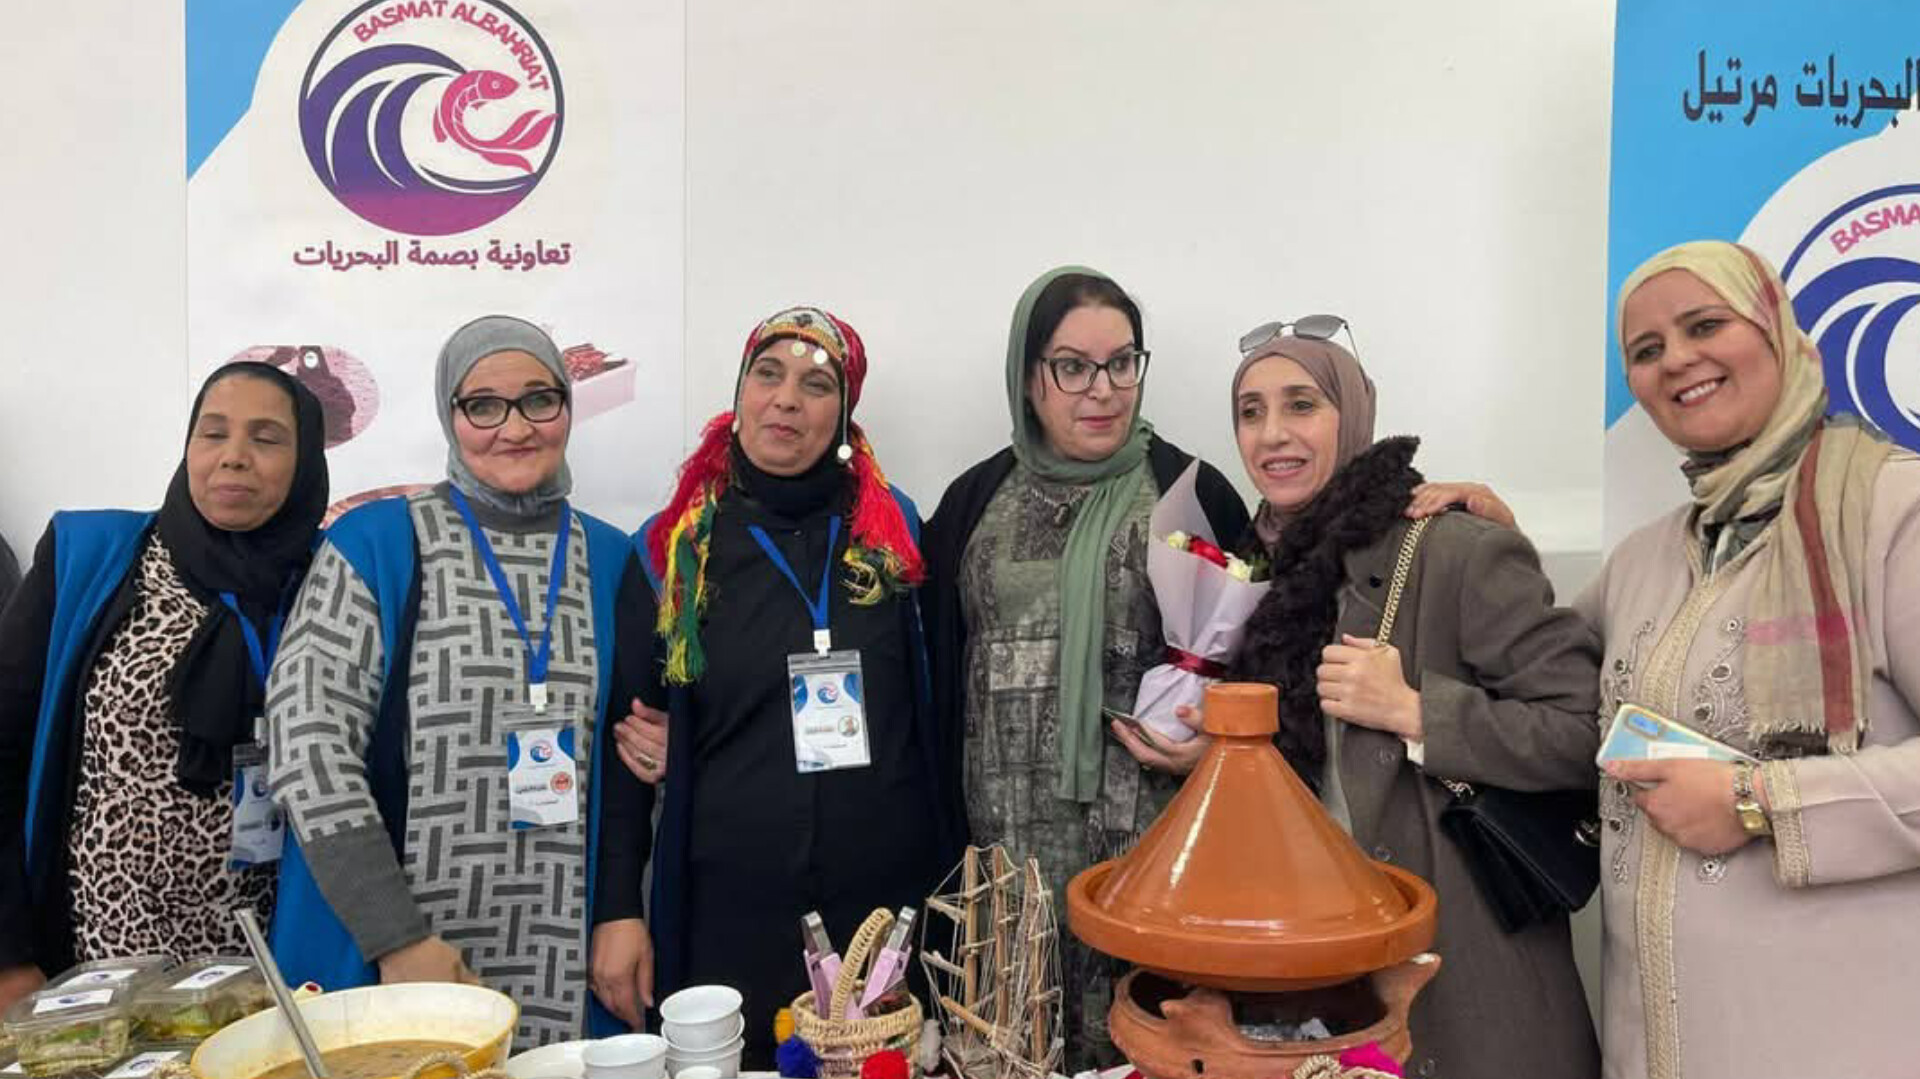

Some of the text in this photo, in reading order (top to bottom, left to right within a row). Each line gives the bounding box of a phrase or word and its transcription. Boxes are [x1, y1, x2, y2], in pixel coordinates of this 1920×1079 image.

[353, 0, 549, 91] BASMAT ALBAHRIAT
[1683, 49, 1777, 126] مرتيل
[293, 239, 571, 271] تعاونية بصمة البحريات
